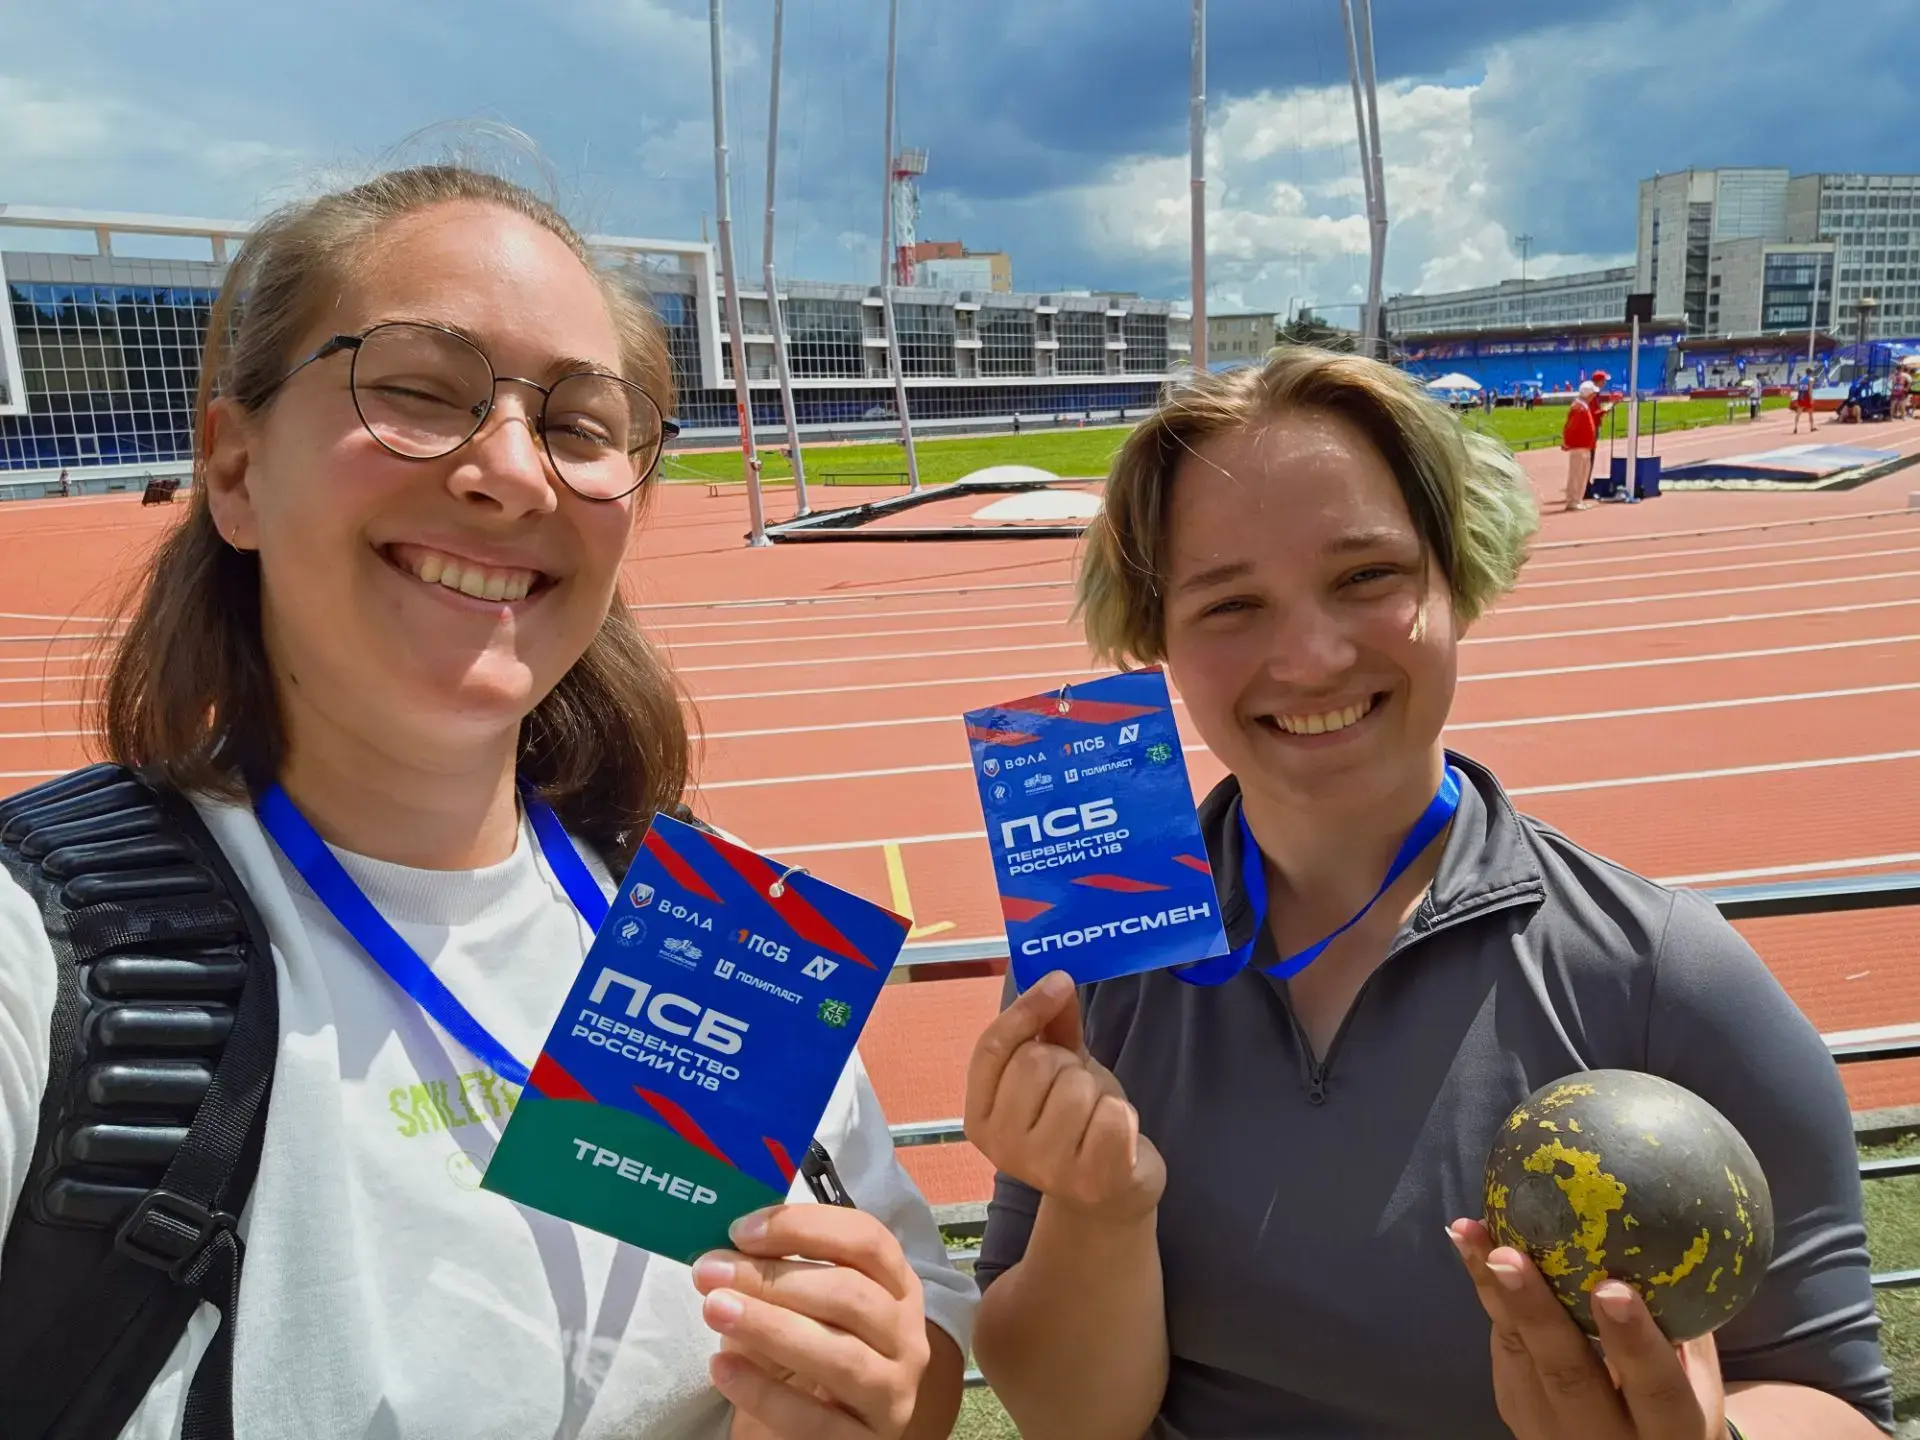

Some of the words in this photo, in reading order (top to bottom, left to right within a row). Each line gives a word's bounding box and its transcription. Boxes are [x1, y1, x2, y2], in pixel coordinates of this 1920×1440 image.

[1004, 752, 1047, 770] ВФЛА
[1073, 736, 1105, 755] ПСБ
[1081, 758, 1133, 777] ПОЛИПЛАСТ
[1000, 797, 1118, 849] ПСБ
[1007, 828, 1130, 864] ПЕРВЕНСТВО
[1009, 850, 1086, 876] РОССИИ
[1089, 843, 1123, 858] U18
[658, 899, 713, 931] ВФЛА
[1021, 902, 1212, 956] СПОРТСМЕН
[747, 934, 791, 963] ПСБ
[735, 971, 803, 1004] ПОЛИПЛАСТ
[588, 966, 750, 1055] ПСБ
[571, 1024, 675, 1073] РОССИИ
[678, 1066, 720, 1091] U18
[578, 1009, 740, 1081] ПЕРВЕНСТВО
[573, 1138, 718, 1204] ТРЕНЕР
